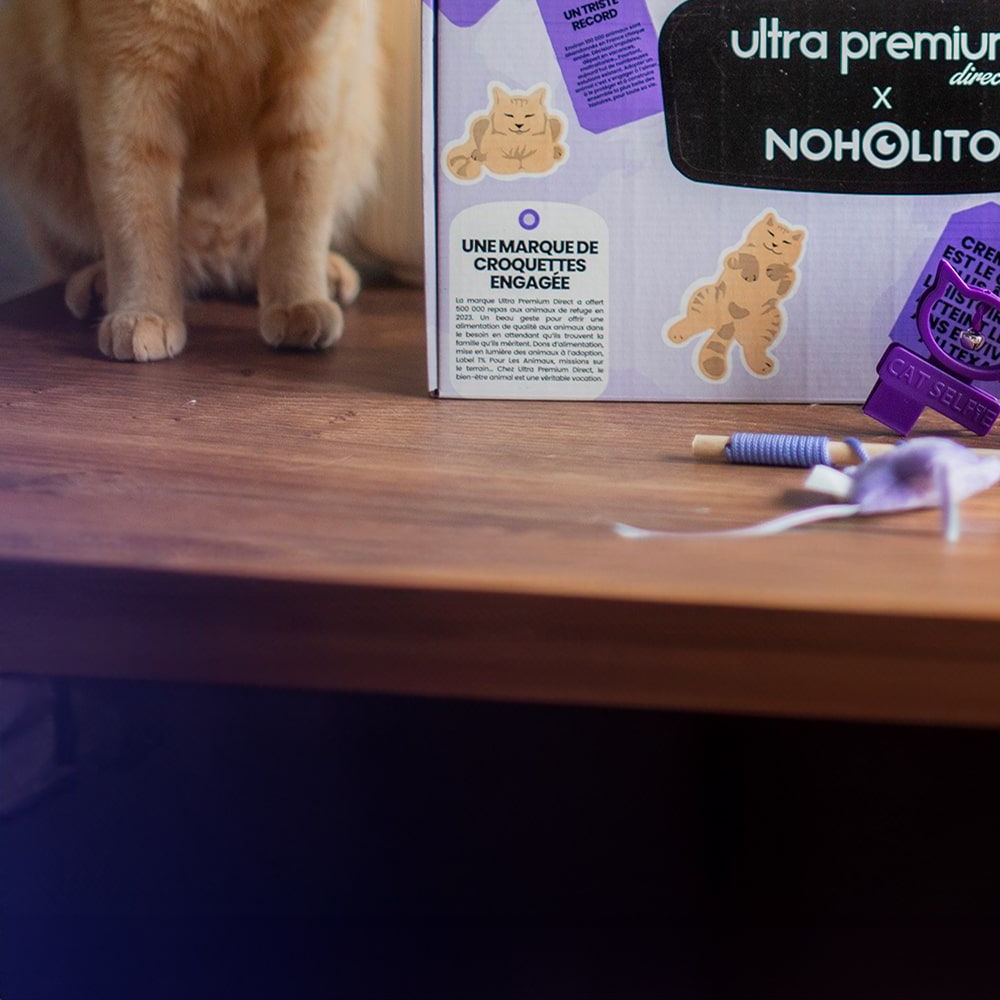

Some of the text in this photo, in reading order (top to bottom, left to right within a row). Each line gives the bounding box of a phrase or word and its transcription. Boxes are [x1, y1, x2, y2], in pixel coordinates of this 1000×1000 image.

[562, 6, 582, 21] UN
[571, 7, 619, 31] RECORD
[731, 18, 827, 60] ultra
[462, 240, 598, 255] UNE MARQUE DE
[474, 258, 586, 273] CROQUETTES
[941, 244, 976, 270] EST
[974, 261, 995, 280] LE
[491, 272, 570, 289] ENGAGÉE
